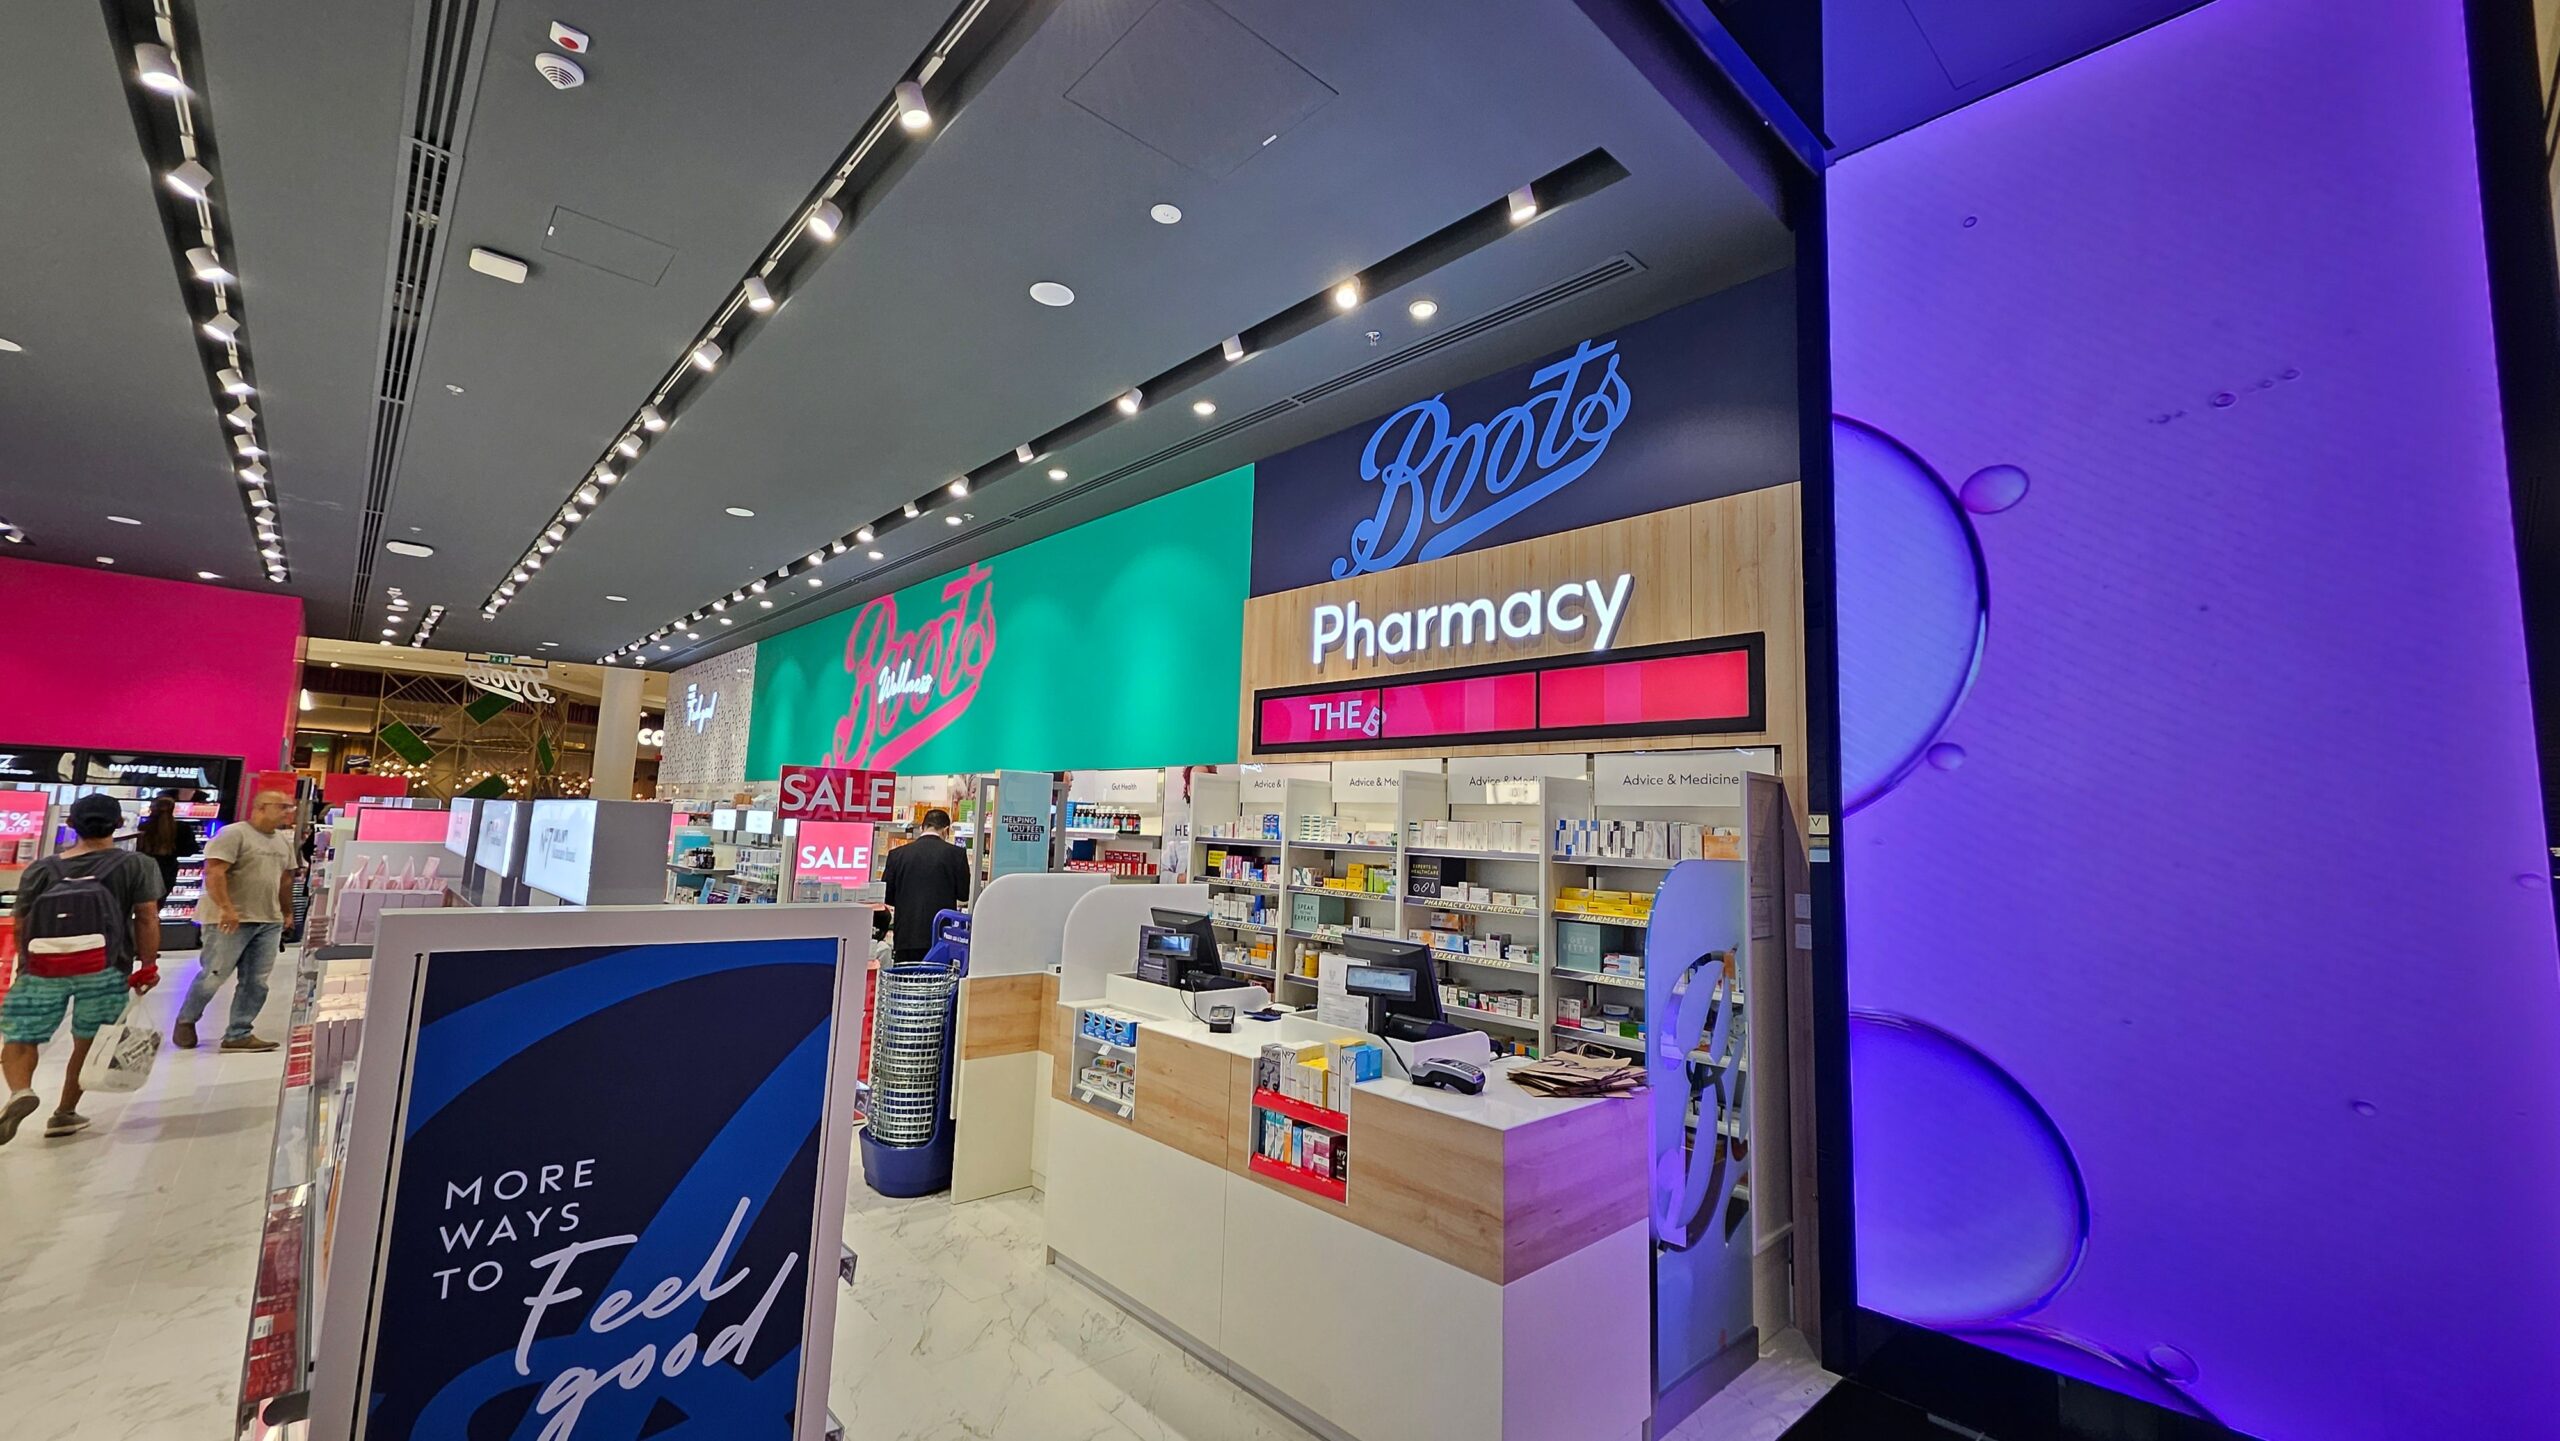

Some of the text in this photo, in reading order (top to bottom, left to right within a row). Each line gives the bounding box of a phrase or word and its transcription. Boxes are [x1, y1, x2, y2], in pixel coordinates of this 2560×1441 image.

[1331, 339, 1632, 580] Boots
[1312, 573, 1632, 665] Pharmacy
[822, 562, 996, 769] Boots
[1309, 700, 1363, 731] THE
[109, 763, 200, 776] MAYBELLINE
[1254, 779, 1276, 789] Advice
[1349, 778, 1375, 787] Advice
[1376, 777, 1383, 787] &
[1622, 773, 1740, 786] Advice & Medicine
[781, 773, 894, 814] SALE
[1003, 816, 1036, 825] HELPING
[1008, 824, 1043, 833] YOU FEEL
[800, 845, 869, 869] SALE
[1423, 899, 1526, 915] PHARMACY ONLY MEDICINE
[1294, 914, 1317, 923] EXPERTS
[1578, 914, 1630, 925] PHARMACY
[1434, 951, 1457, 961] SPEAK
[1478, 958, 1511, 968] EXPERTS
[1593, 974, 1622, 985] SPEAK
[445, 1159, 595, 1210] MORE
[439, 1202, 580, 1254] WAYS
[432, 1197, 751, 1375] TO Feel
[536, 1252, 798, 1441] good
